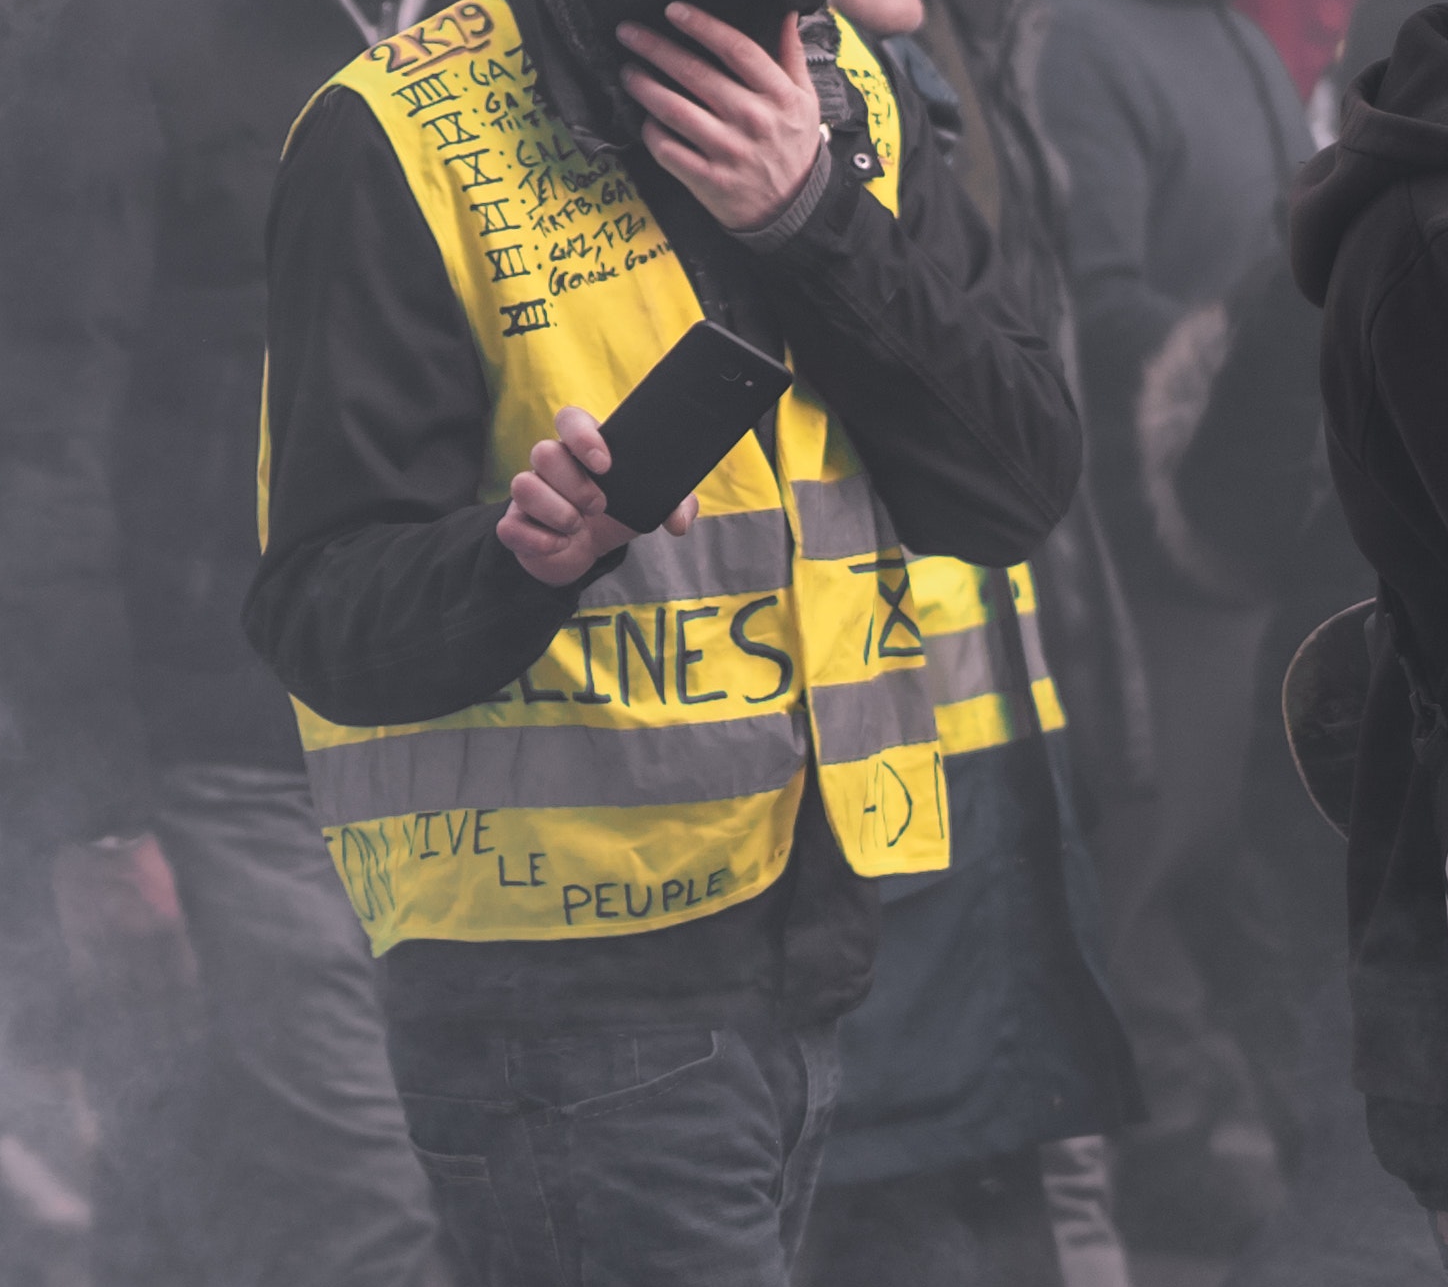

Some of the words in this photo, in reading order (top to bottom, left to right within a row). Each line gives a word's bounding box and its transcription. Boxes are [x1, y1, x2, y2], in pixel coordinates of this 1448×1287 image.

[368, 2, 495, 74] 2K19
[497, 853, 548, 888] LE
[562, 868, 729, 925] PEUPLE
